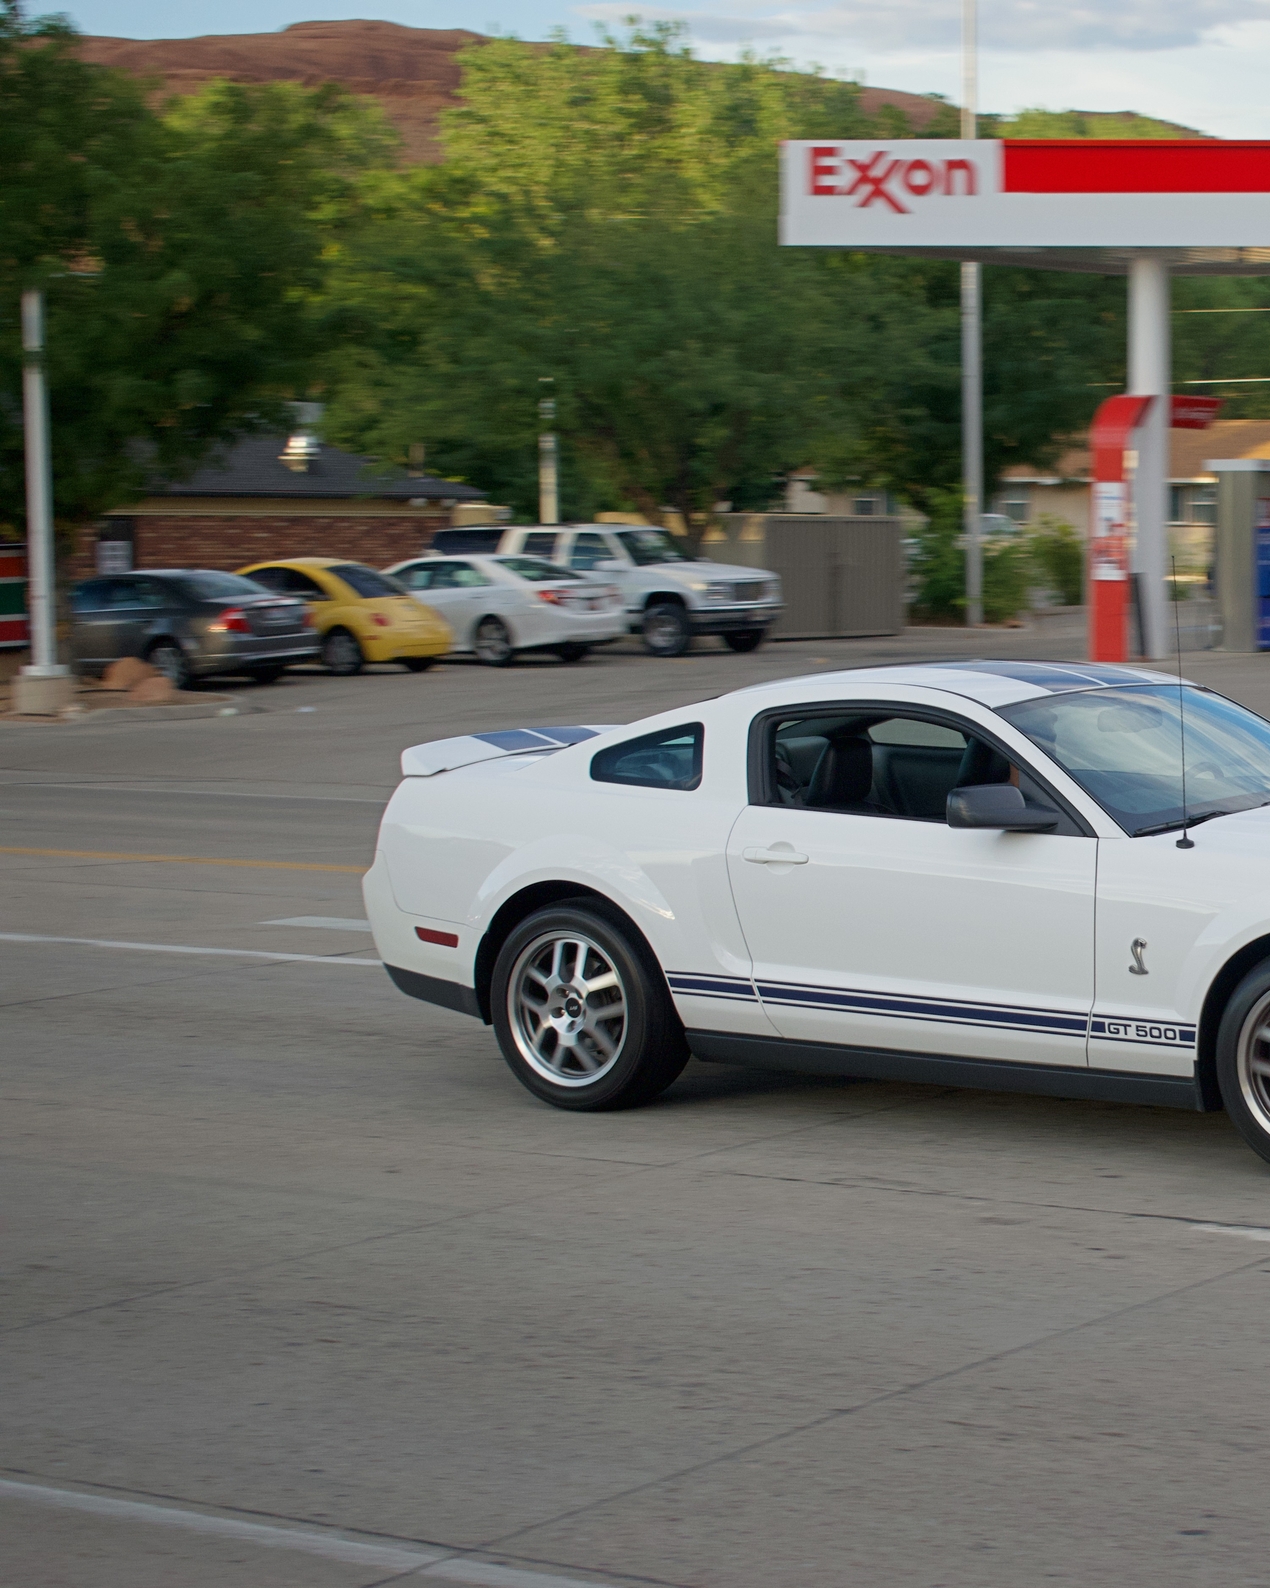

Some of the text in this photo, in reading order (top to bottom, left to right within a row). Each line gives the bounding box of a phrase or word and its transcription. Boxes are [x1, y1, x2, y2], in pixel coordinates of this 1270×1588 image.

[806, 146, 978, 214] Exxon
[1107, 1022, 1177, 1041] GT 500
